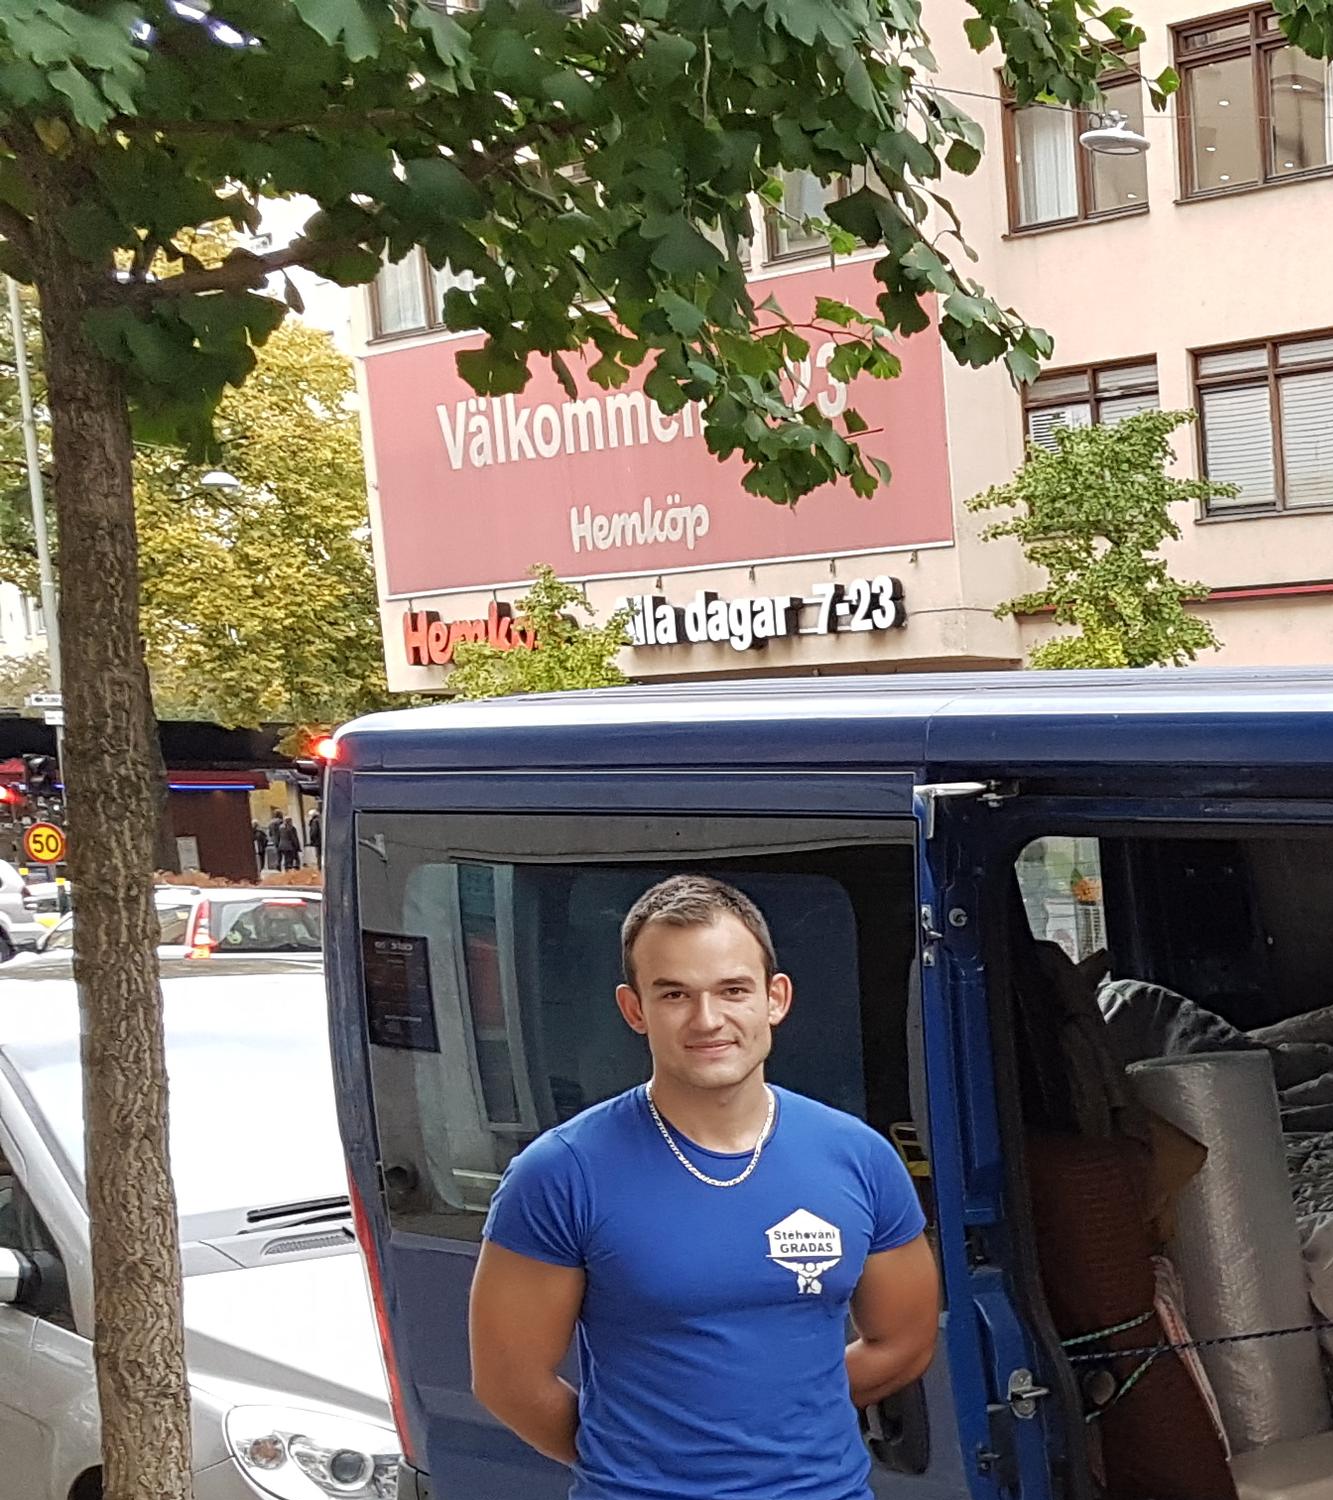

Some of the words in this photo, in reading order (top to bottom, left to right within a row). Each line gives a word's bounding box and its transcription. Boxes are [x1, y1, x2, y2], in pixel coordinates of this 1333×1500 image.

[570, 494, 711, 553] Hemköp
[403, 600, 545, 666] Hemk
[684, 590, 791, 652] dagar
[811, 574, 898, 635] 7-23
[32, 833, 59, 854] 50
[779, 1242, 834, 1254] GRADAS
